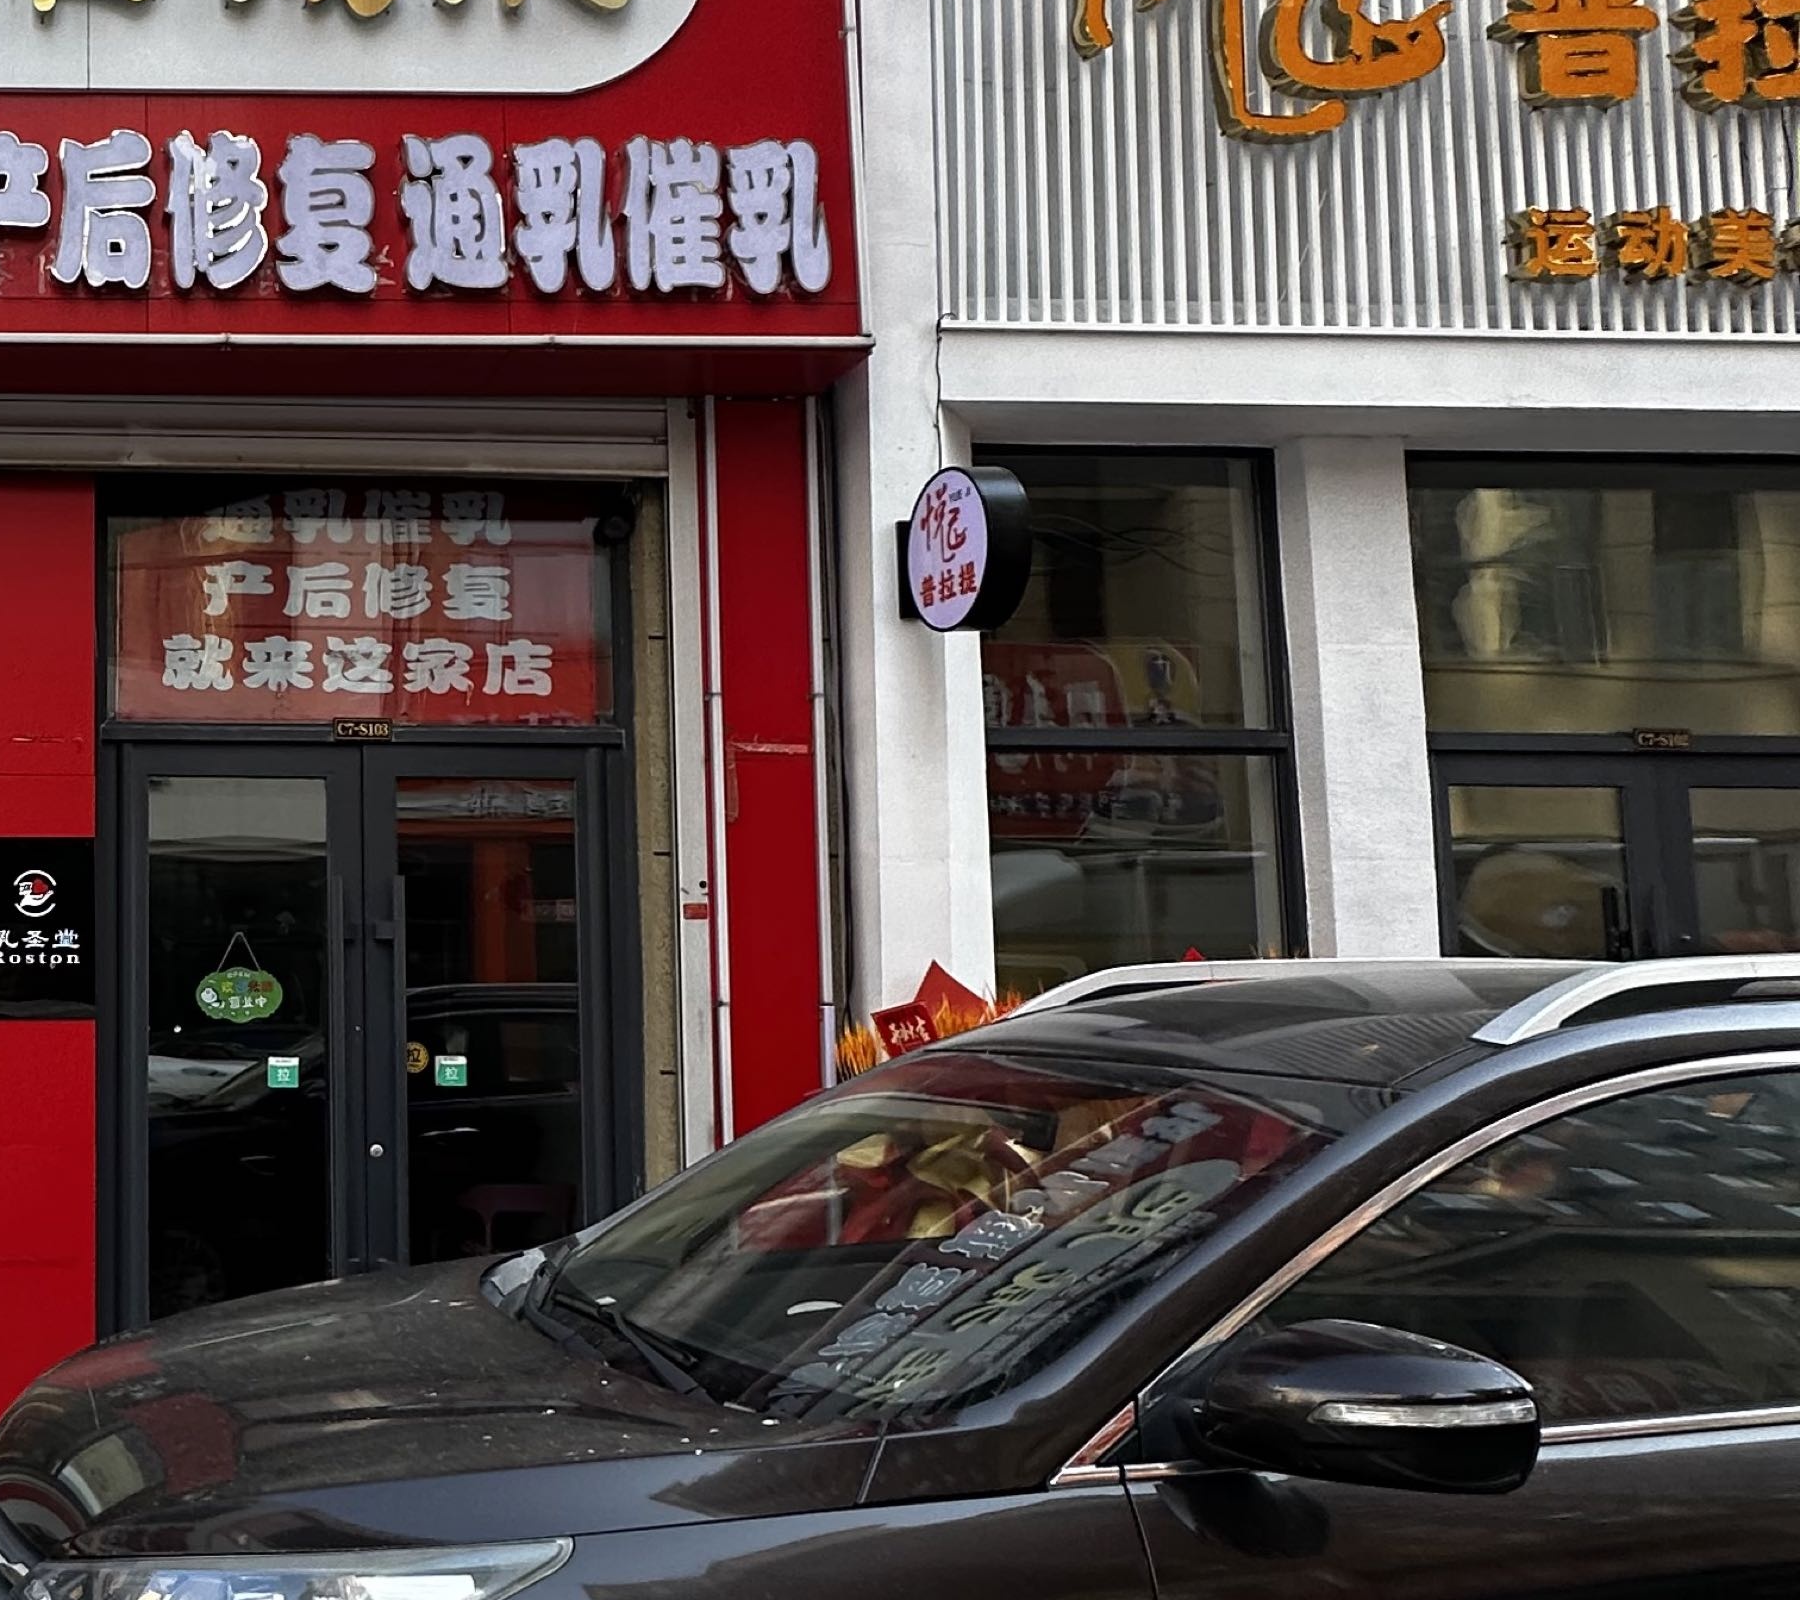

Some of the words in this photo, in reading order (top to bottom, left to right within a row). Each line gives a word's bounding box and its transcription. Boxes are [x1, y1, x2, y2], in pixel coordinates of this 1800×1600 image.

[202, 488, 512, 546] 通乳催乳
[203, 561, 513, 622] 产后修复
[920, 561, 977, 609] 普拉提
[161, 633, 553, 697] 就来这家店
[336, 721, 390, 738] C7-S103
[227, 994, 268, 1009] 营业中
[277, 1067, 291, 1082] 拉
[444, 1066, 459, 1081] 拉
